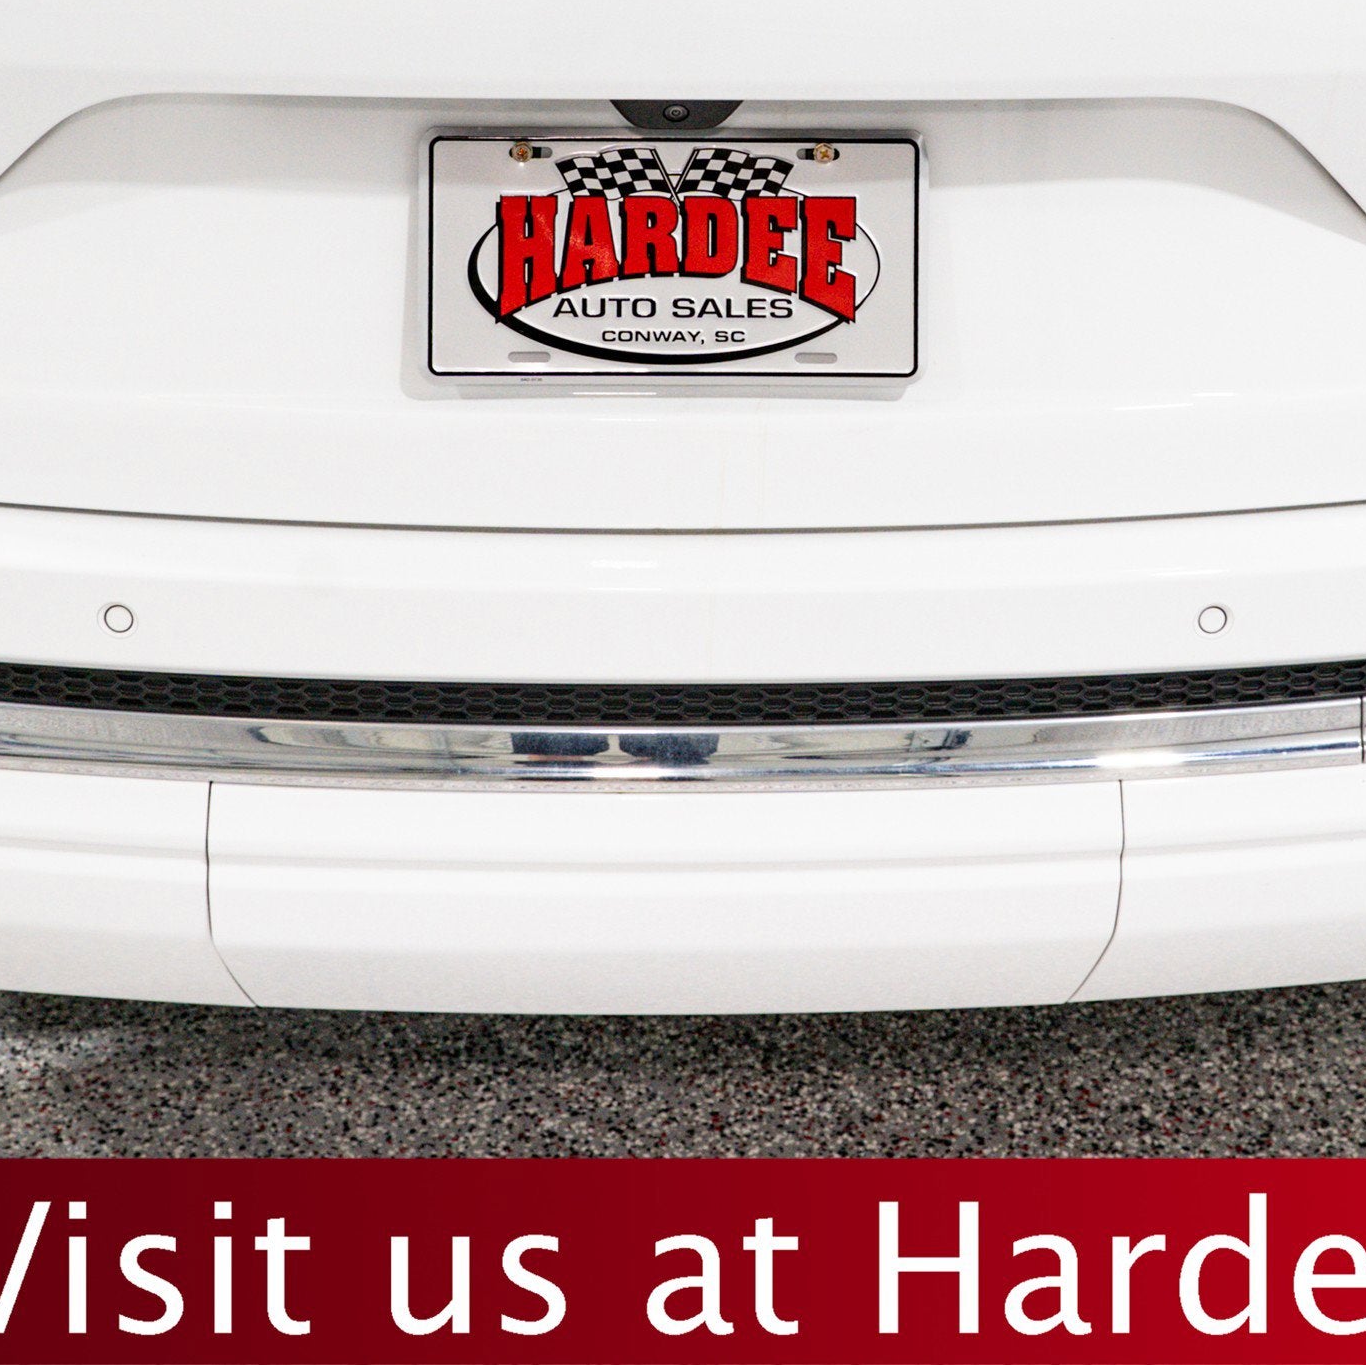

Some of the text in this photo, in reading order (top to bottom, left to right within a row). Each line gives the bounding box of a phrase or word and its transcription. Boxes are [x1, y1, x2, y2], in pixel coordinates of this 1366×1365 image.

[496, 193, 856, 324] HARDEE
[552, 297, 794, 320] AUTO SALES
[601, 329, 746, 345] CONWAY, SC
